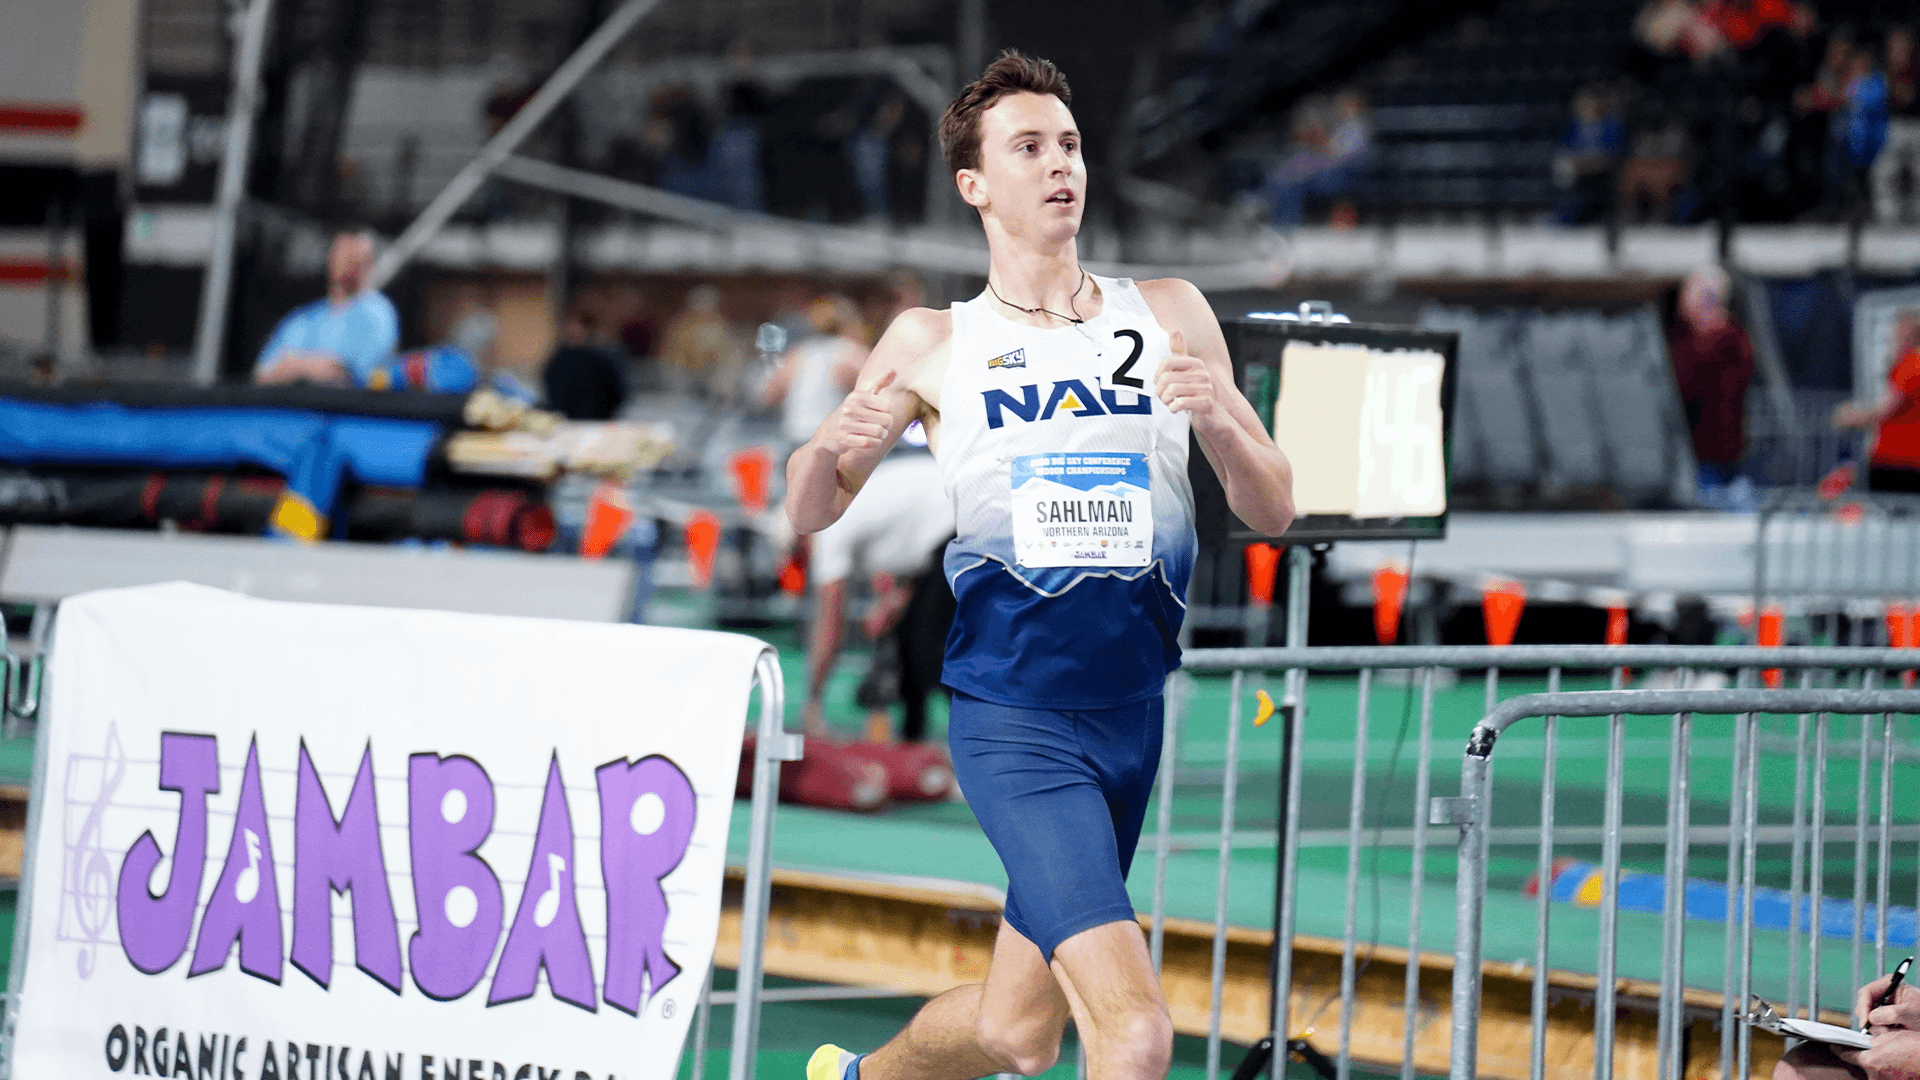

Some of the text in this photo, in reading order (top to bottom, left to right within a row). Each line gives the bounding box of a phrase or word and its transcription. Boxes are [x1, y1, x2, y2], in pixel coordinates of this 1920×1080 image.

[1111, 328, 1145, 390] 2
[980, 376, 1153, 430] NAU
[1066, 457, 1081, 466] SKY
[1083, 457, 1131, 466] CONFERENCE
[1066, 466, 1127, 476] CHAMPIONSHIPS
[1036, 500, 1133, 524] SAHLMAN
[1043, 526, 1129, 537] NORTHERN ARIZONA
[1073, 550, 1108, 559] JAMBAR
[116, 730, 697, 1018] JAMBAR
[105, 1024, 248, 1080] ORGANIC
[260, 1040, 404, 1080] ARTISAN
